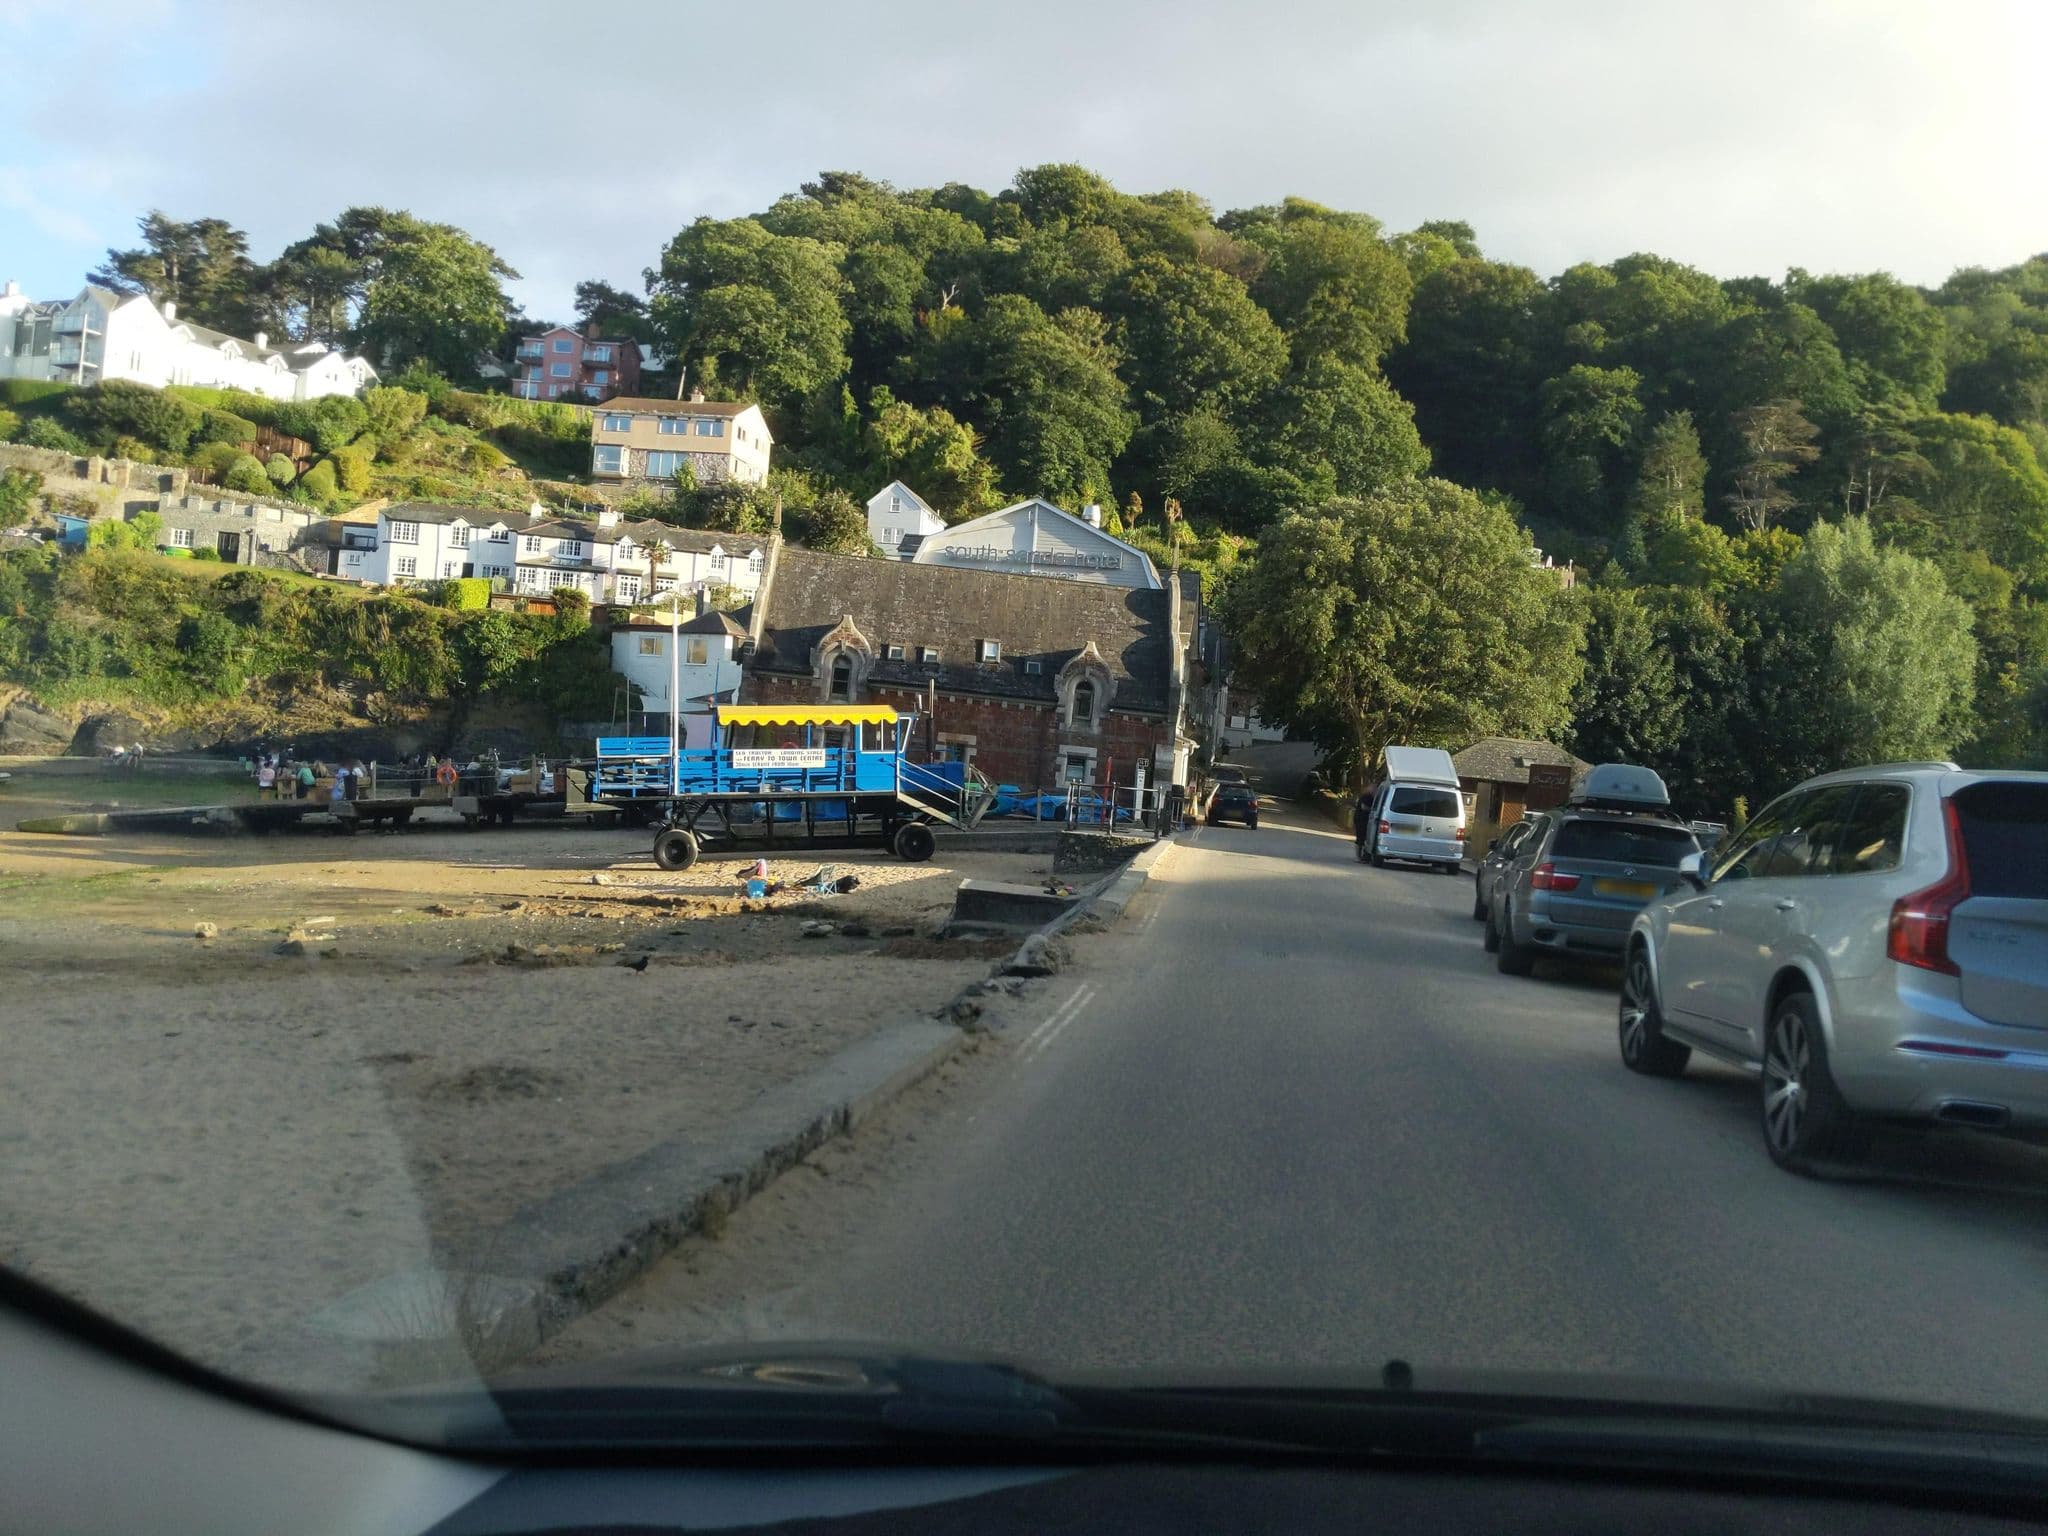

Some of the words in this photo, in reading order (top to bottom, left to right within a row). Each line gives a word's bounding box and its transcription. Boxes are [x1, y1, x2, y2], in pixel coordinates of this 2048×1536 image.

[944, 544, 999, 561] south
[1006, 547, 1065, 566] sands
[1074, 547, 1124, 569] hotel
